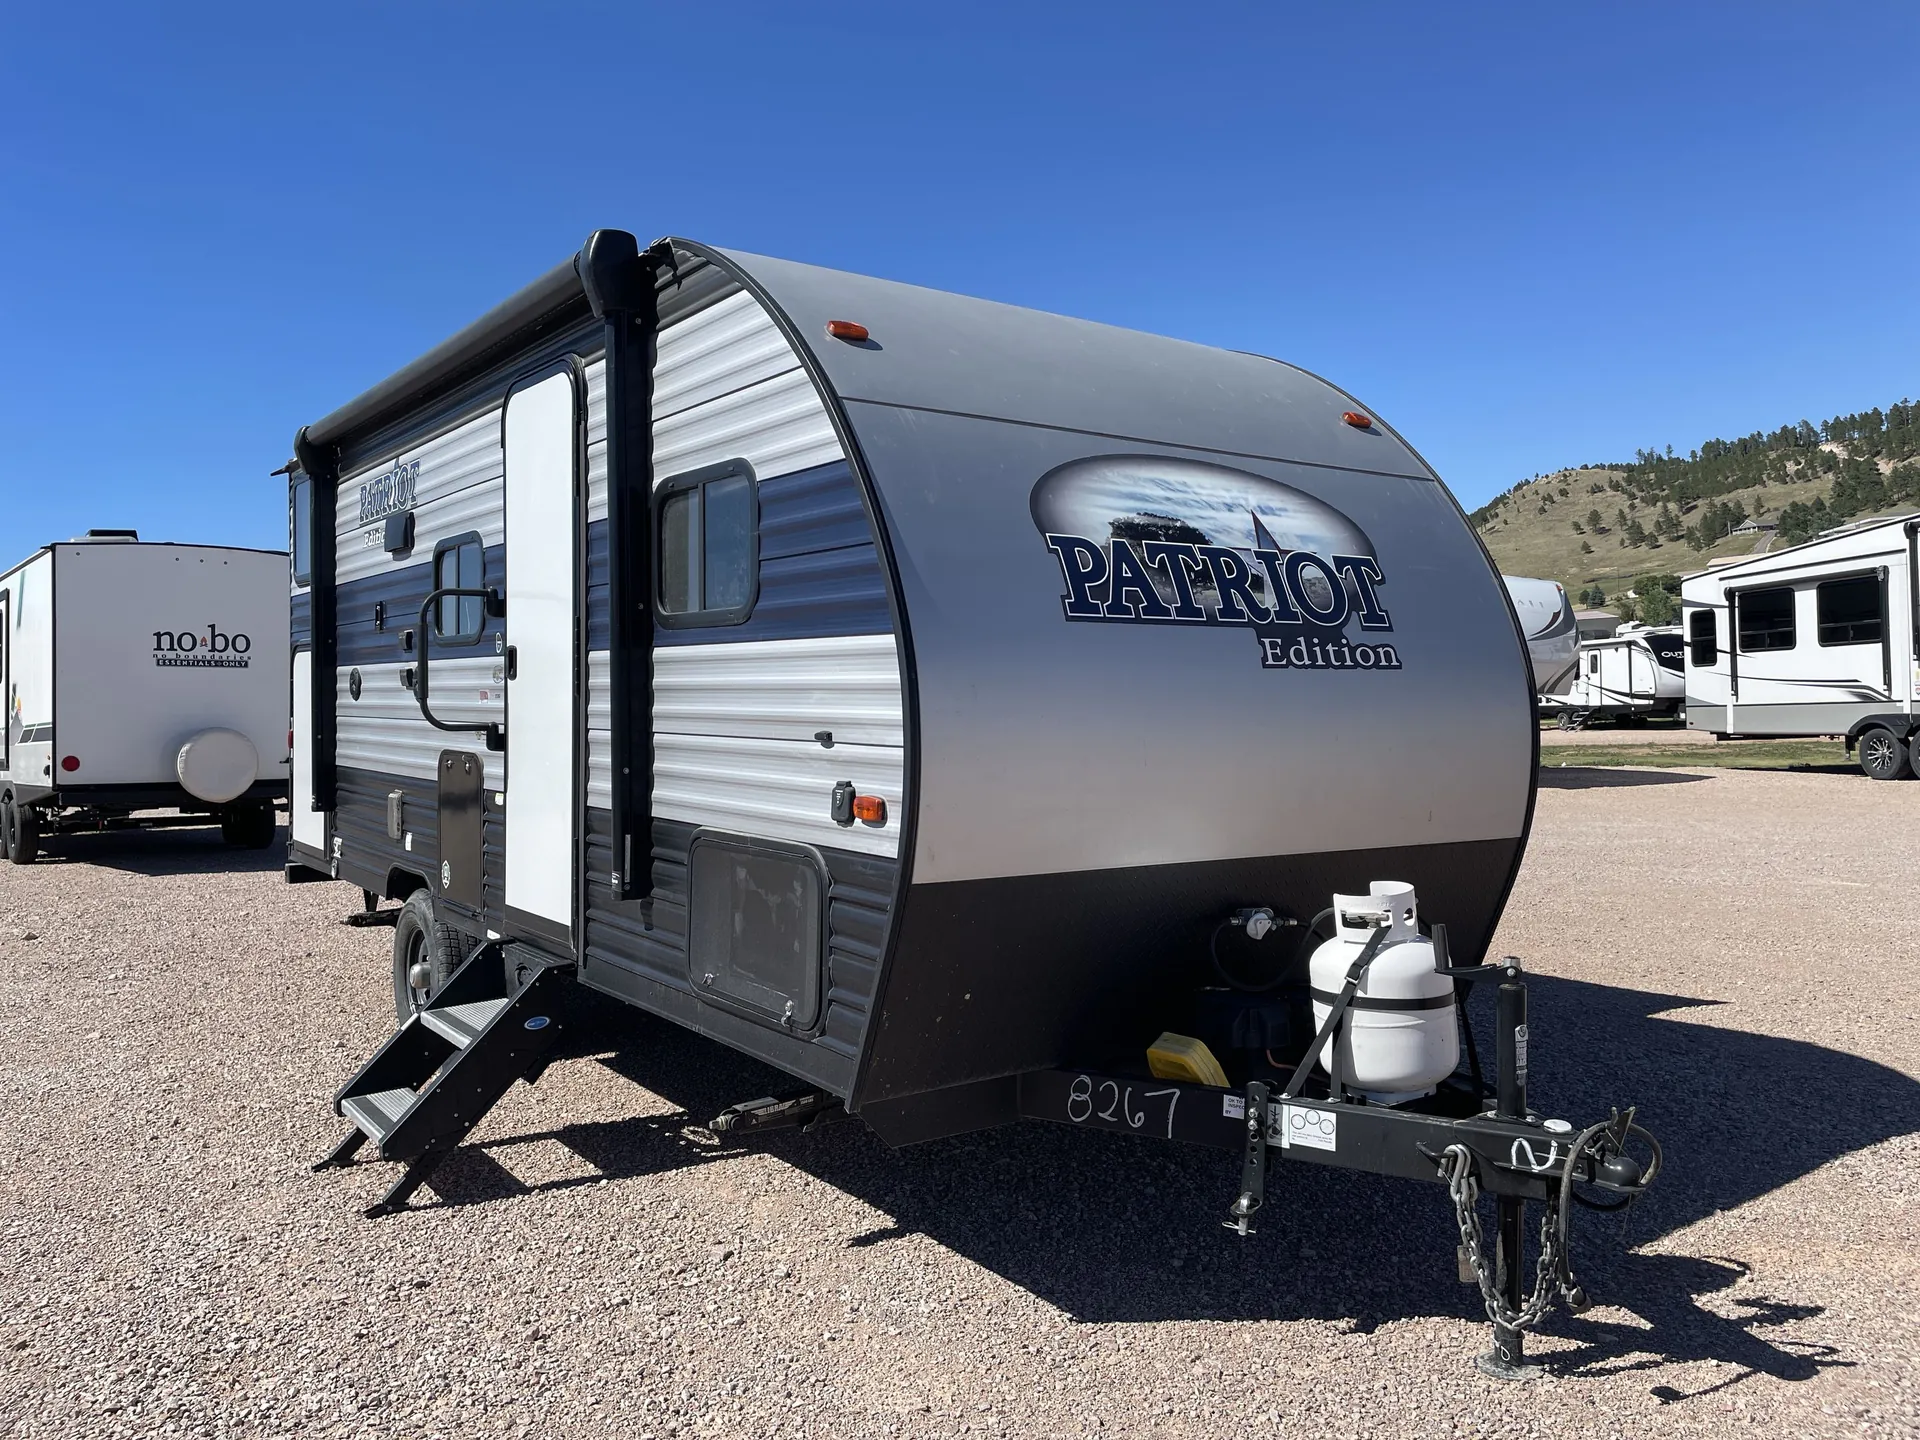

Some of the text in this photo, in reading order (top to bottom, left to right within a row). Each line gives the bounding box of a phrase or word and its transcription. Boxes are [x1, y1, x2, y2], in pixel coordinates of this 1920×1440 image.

[359, 458, 420, 525] PATRIOT
[1045, 532, 1391, 629] PATRIOT
[158, 659, 247, 668] ESSENTIALS ONLY
[175, 653, 252, 661] boundaries
[1260, 636, 1401, 667] Edition
[1066, 1074, 1181, 1140] 8267
